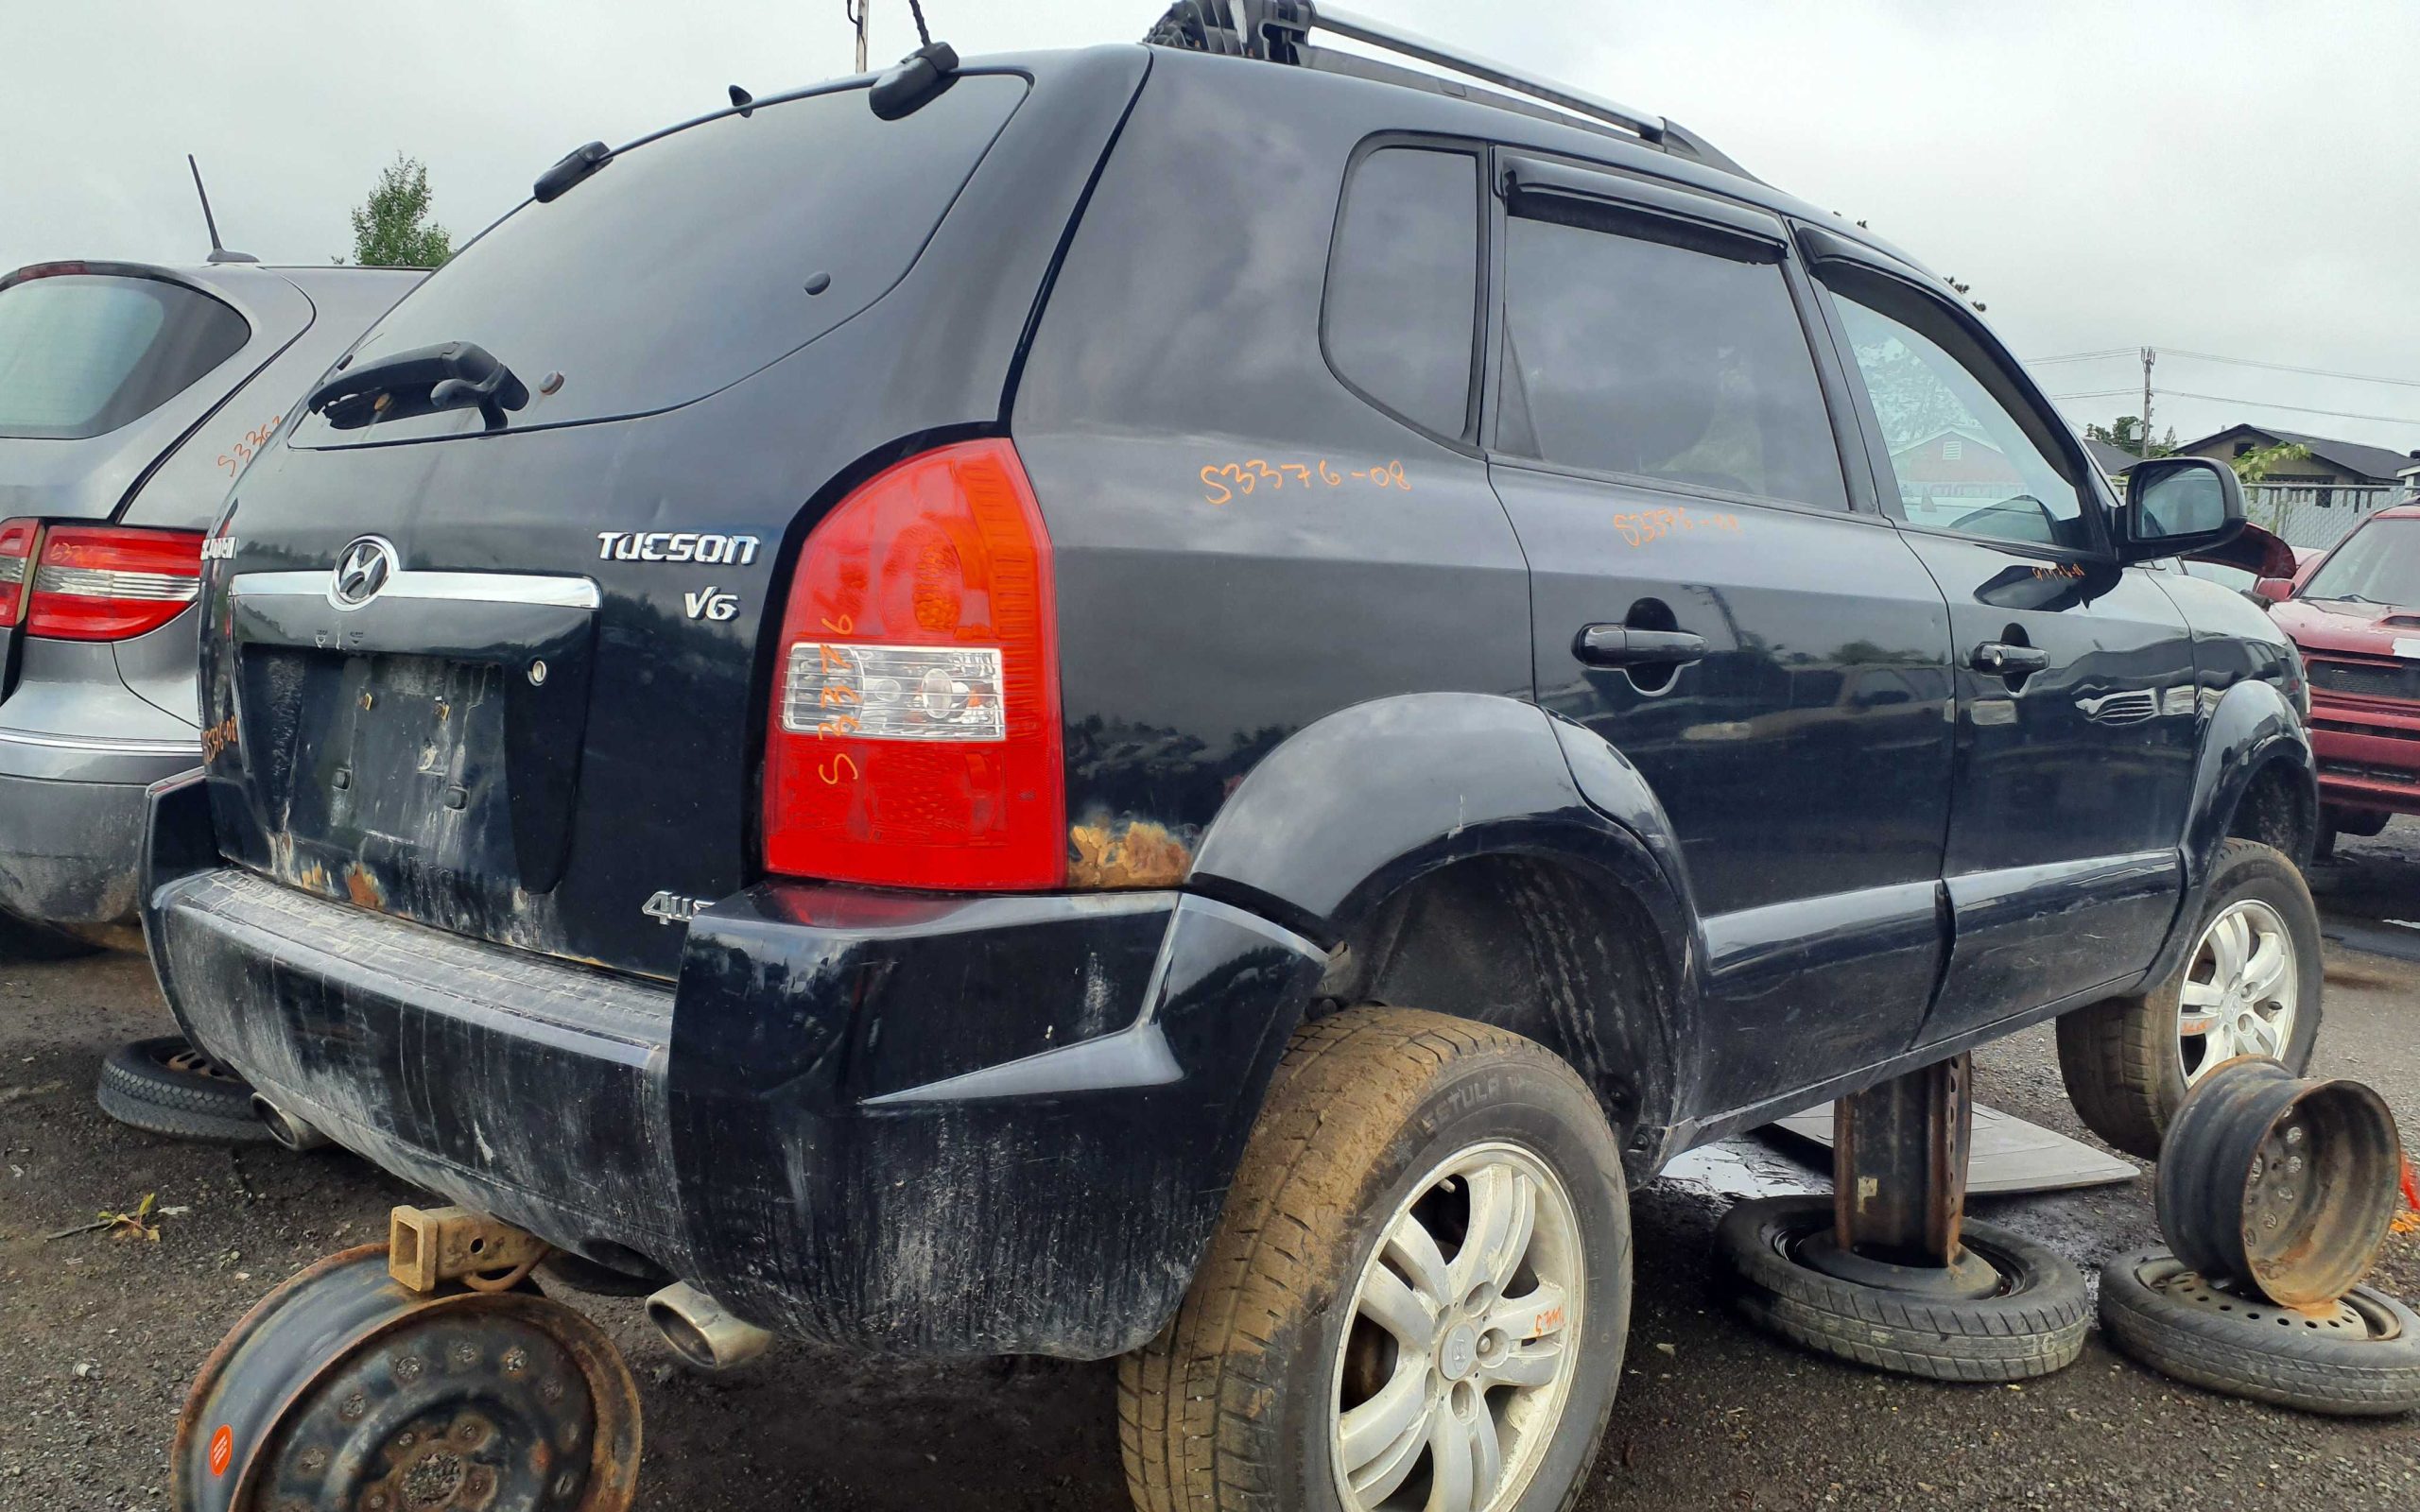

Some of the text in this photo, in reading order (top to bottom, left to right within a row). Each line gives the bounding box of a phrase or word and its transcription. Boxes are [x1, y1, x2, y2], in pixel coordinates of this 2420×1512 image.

[1200, 459, 1412, 505] S3376-08
[597, 531, 762, 566] TUCSON
[684, 585, 741, 622] V6
